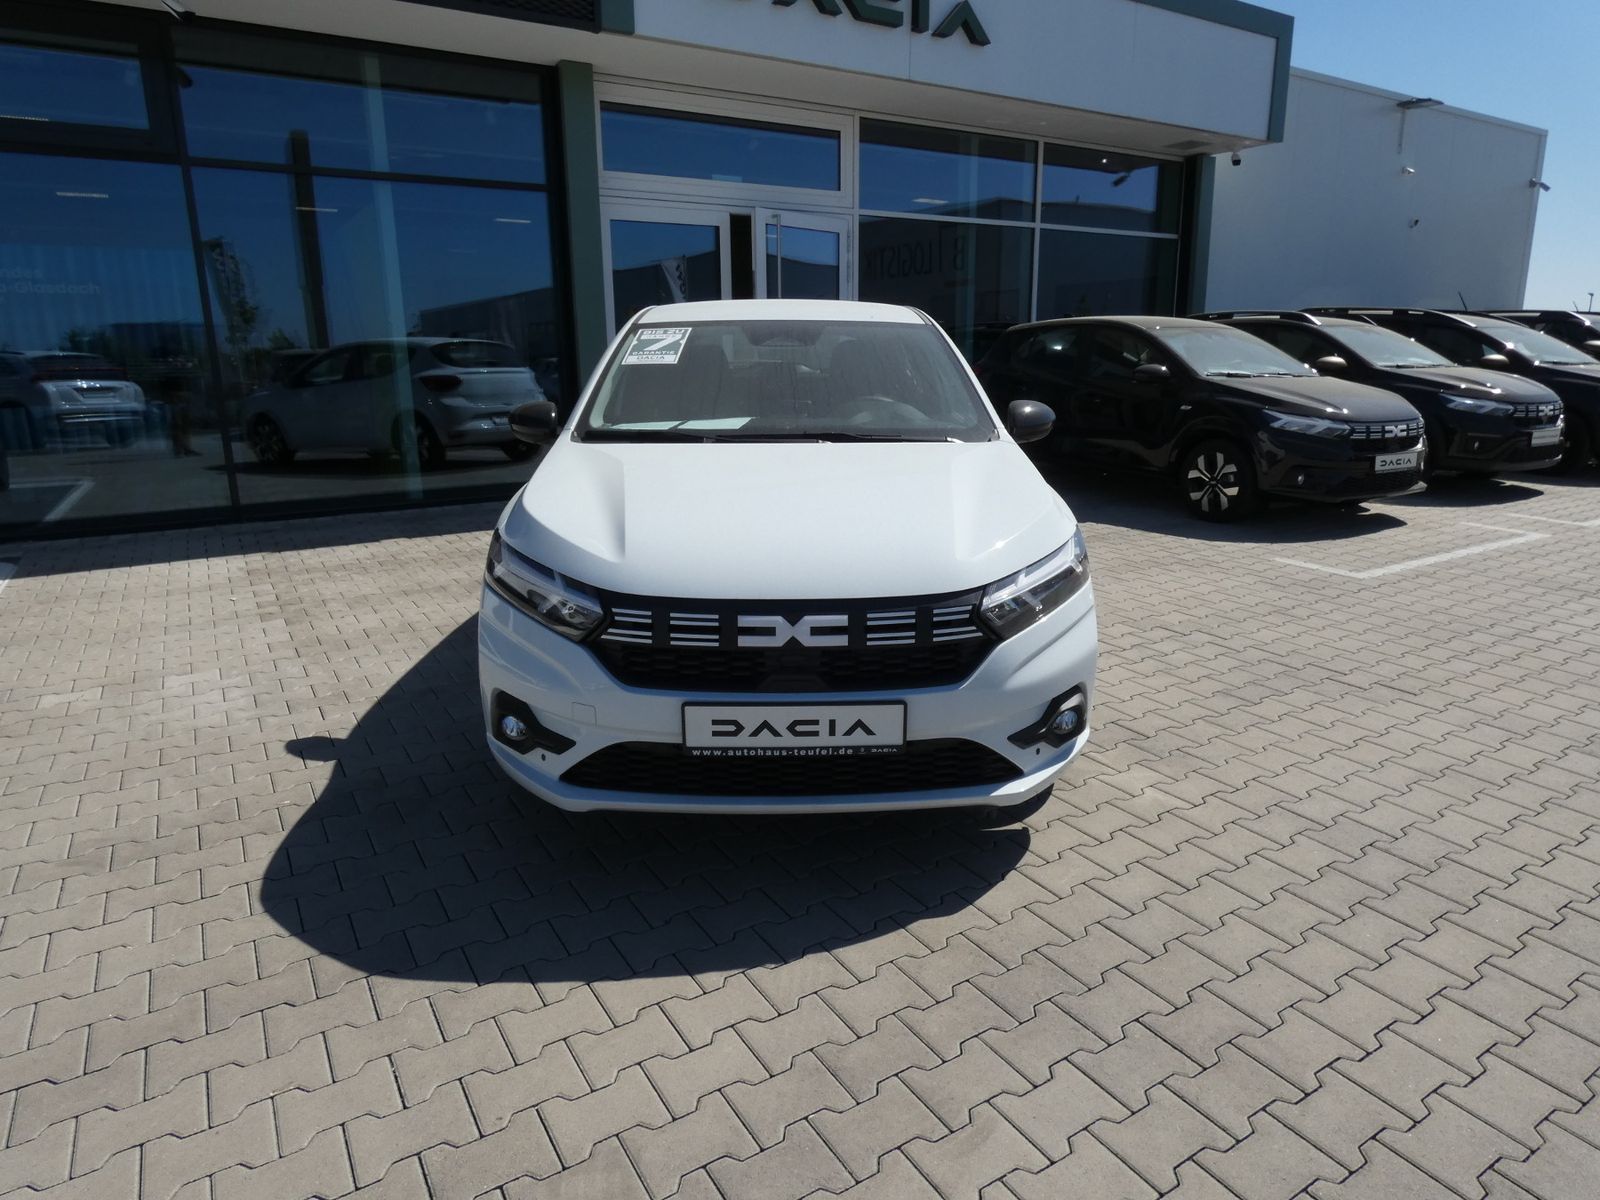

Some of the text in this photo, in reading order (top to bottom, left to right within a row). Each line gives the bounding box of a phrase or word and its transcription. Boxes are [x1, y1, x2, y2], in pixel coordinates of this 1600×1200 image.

[770, 0, 991, 46] CIA
[1379, 457, 1412, 467] DACIA
[711, 718, 877, 737] DACIA
[691, 747, 854, 756] www.autohaus-teufel.de
